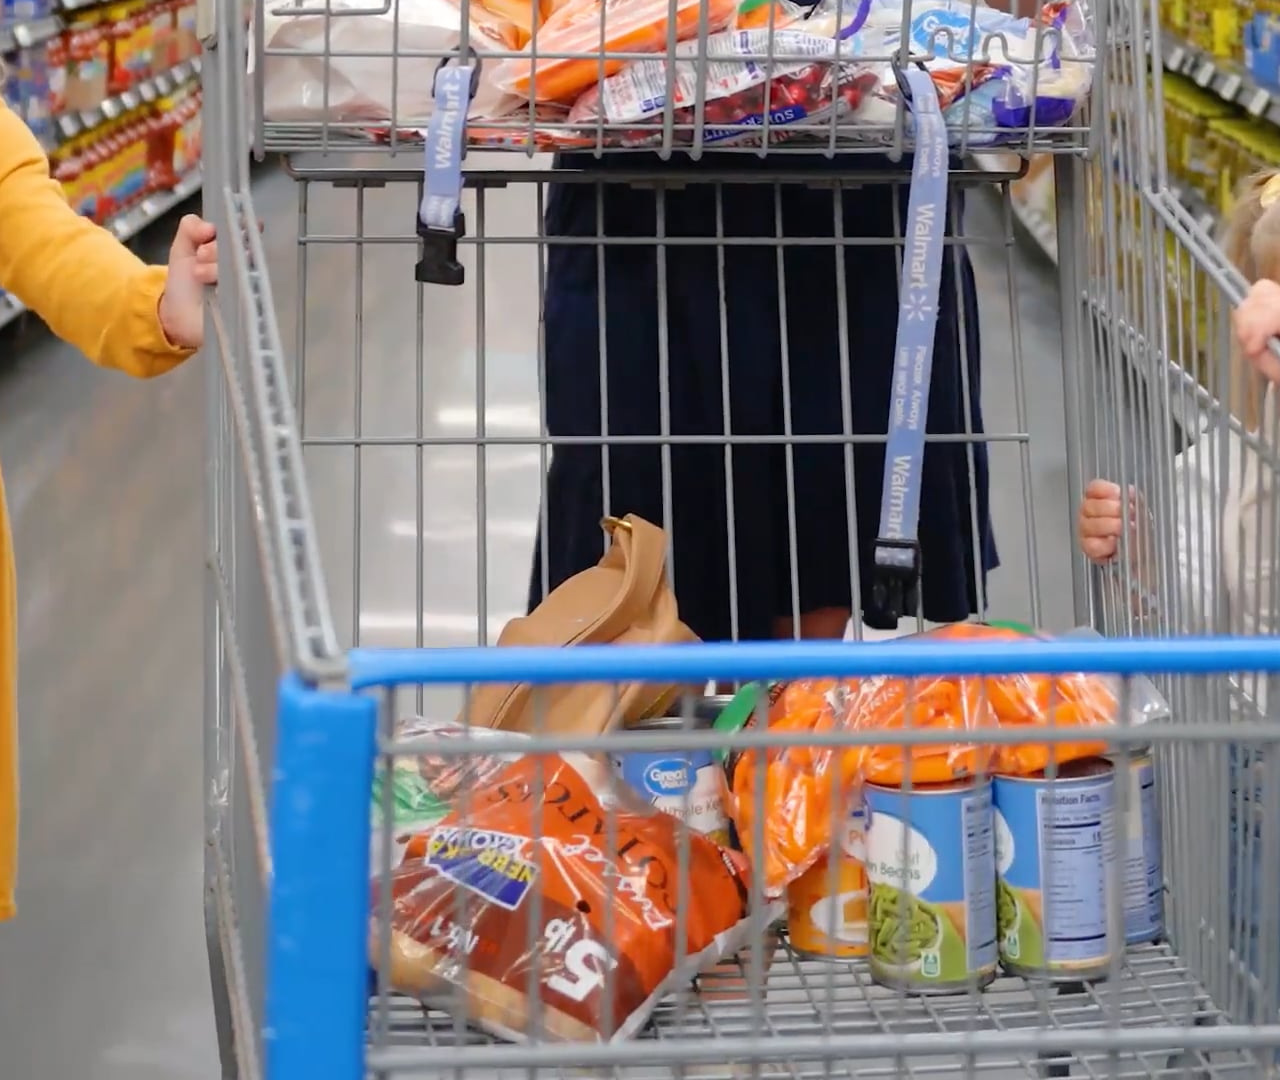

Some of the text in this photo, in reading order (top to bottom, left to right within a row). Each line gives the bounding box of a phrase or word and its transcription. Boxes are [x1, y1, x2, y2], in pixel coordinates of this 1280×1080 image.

[433, 83, 461, 170] Walmart
[910, 205, 936, 290] Walmart
[908, 389, 923, 431] Always
[888, 455, 912, 540] Walmart
[548, 939, 618, 1002] 5
